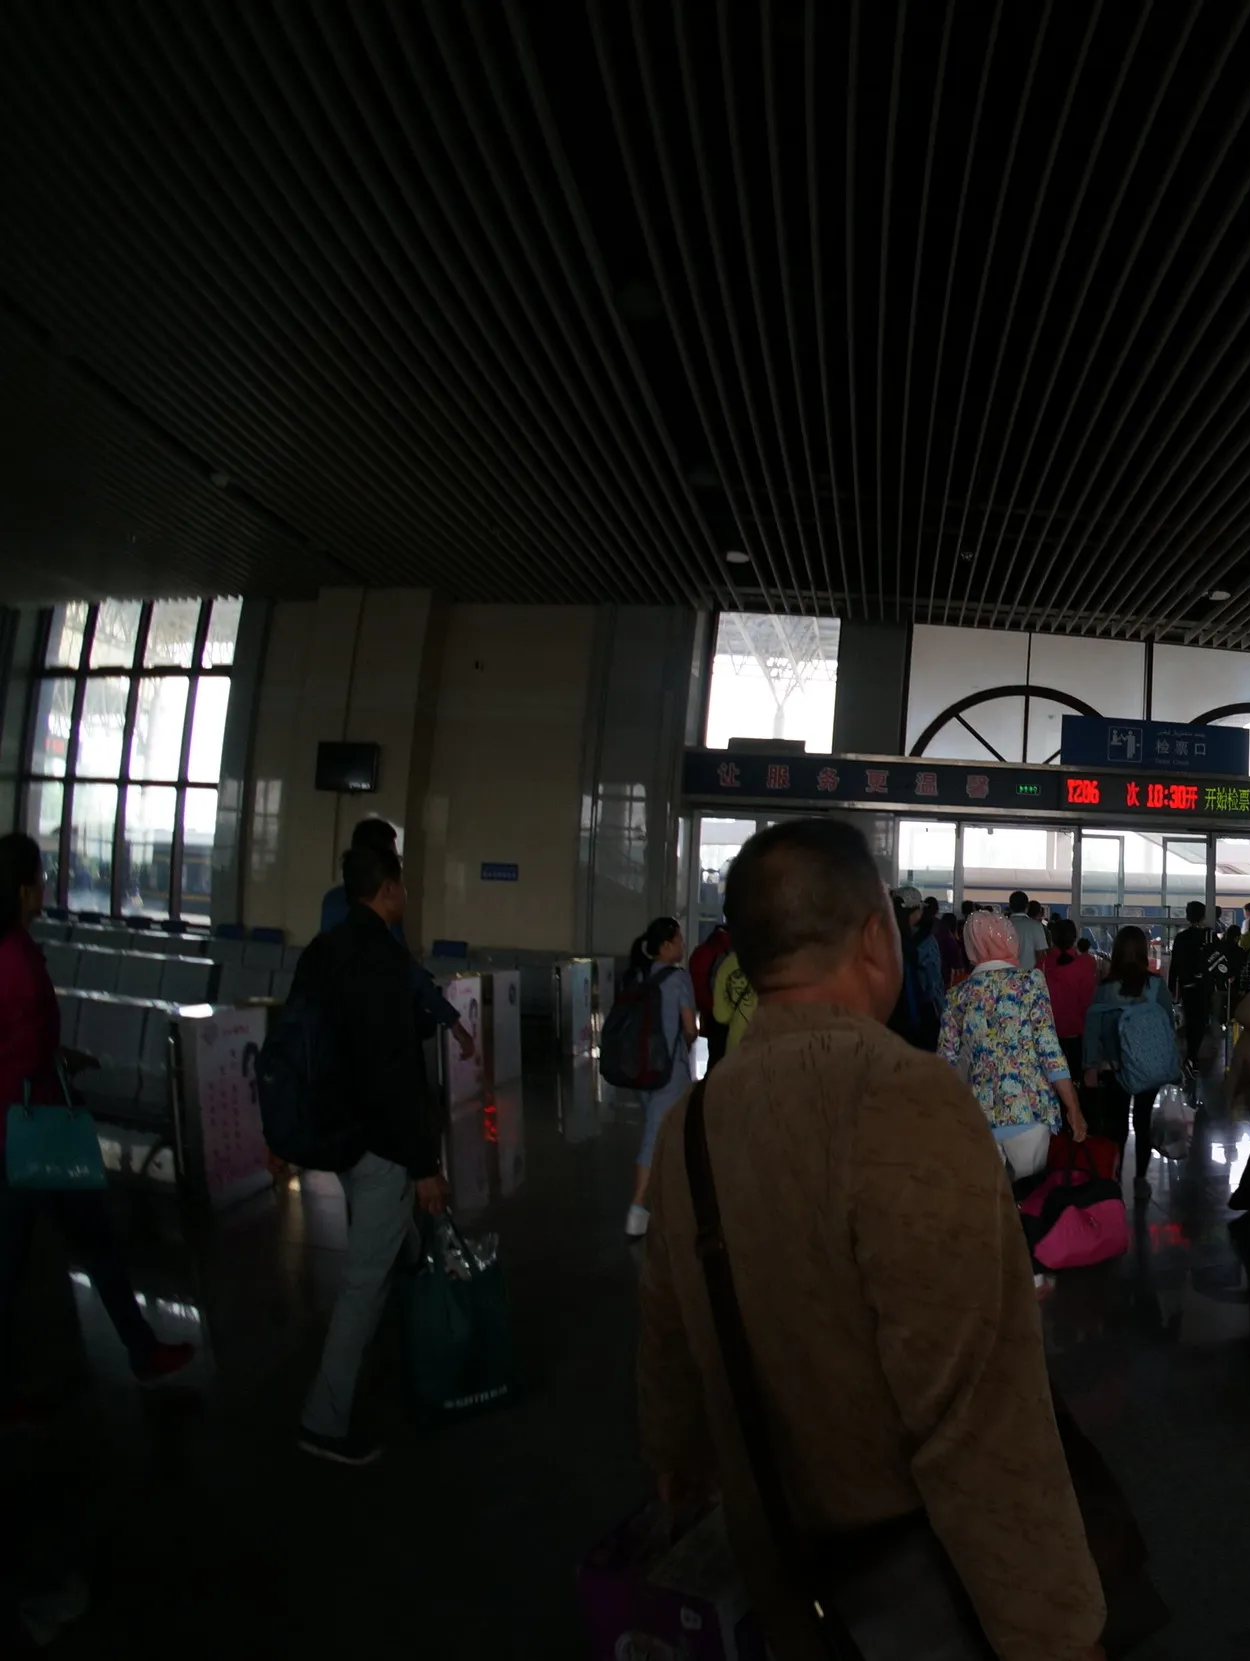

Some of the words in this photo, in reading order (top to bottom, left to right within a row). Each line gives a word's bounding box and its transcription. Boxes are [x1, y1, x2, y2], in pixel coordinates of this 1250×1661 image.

[1155, 739, 1207, 757] 检票口
[1126, 781, 1140, 807] 次
[1204, 786, 1250, 812] 开始检票
